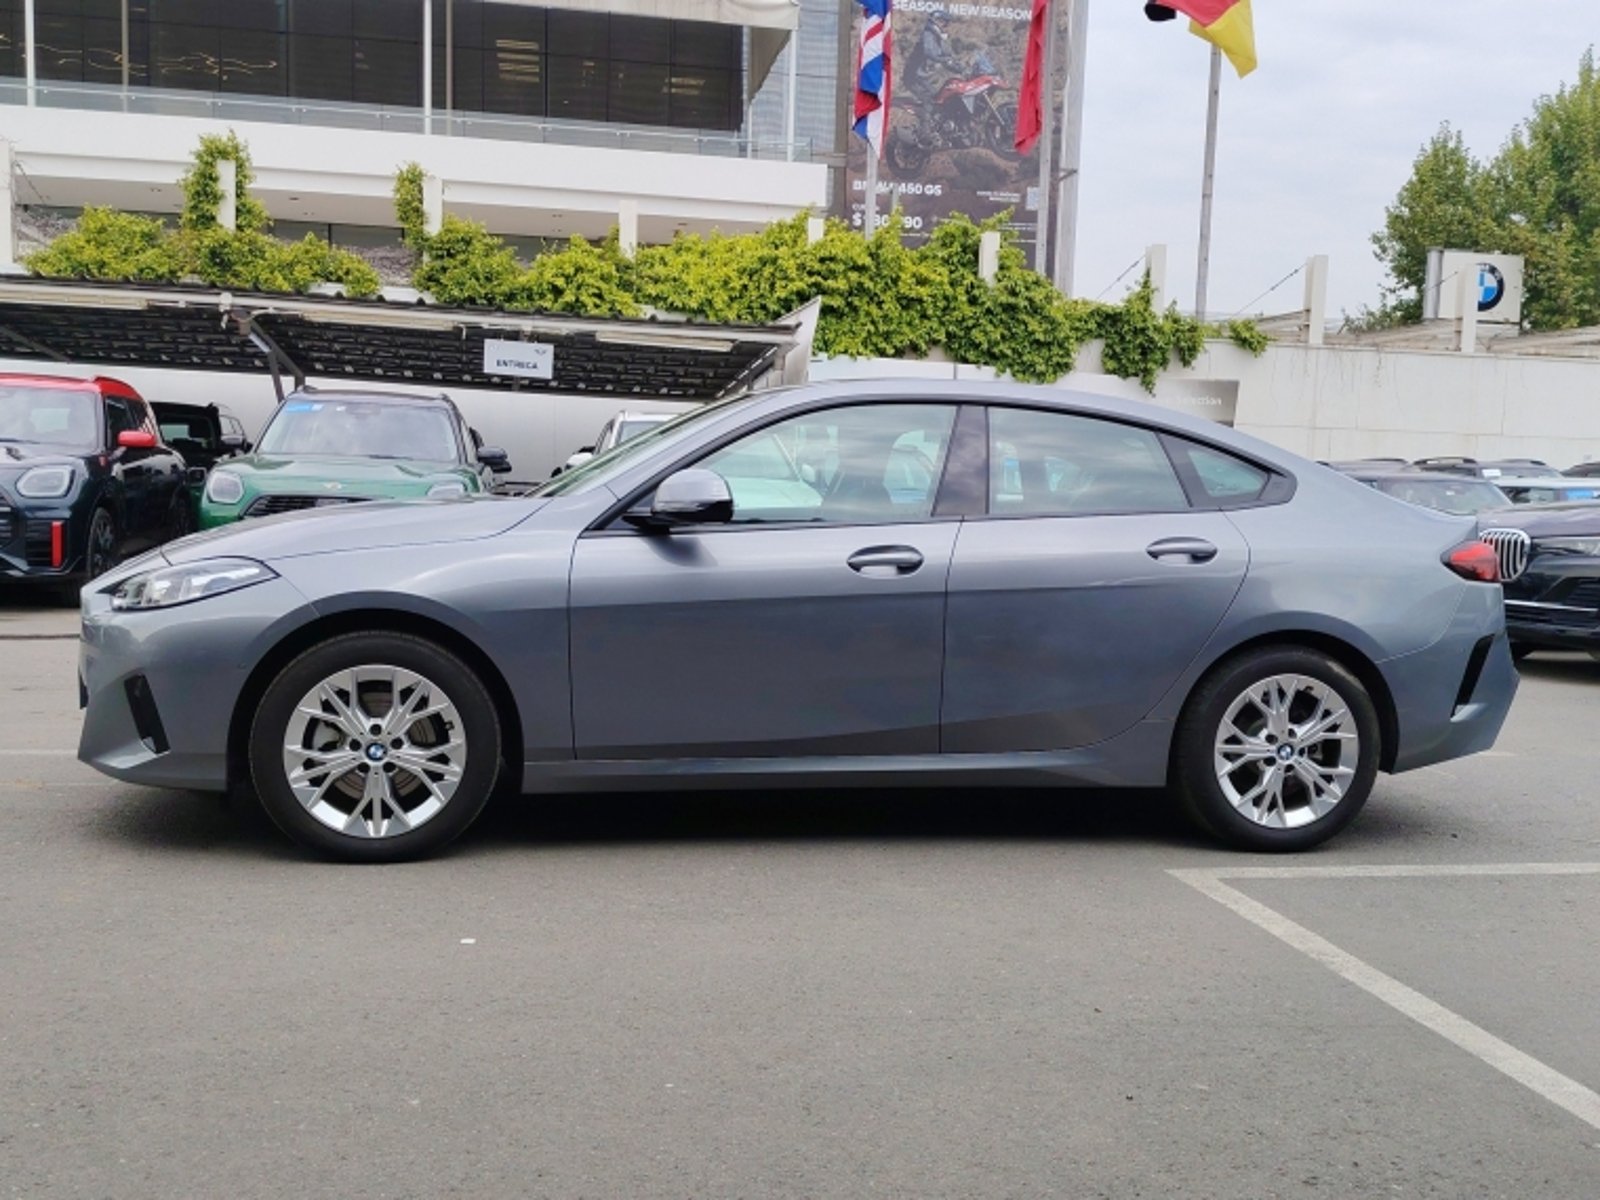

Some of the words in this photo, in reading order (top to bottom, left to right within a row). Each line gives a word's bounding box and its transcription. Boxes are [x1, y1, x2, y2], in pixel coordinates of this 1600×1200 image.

[949, 3, 980, 16] NEW
[981, 6, 1033, 20] REASON
[898, 182, 922, 195] 450
[924, 184, 942, 197] GS
